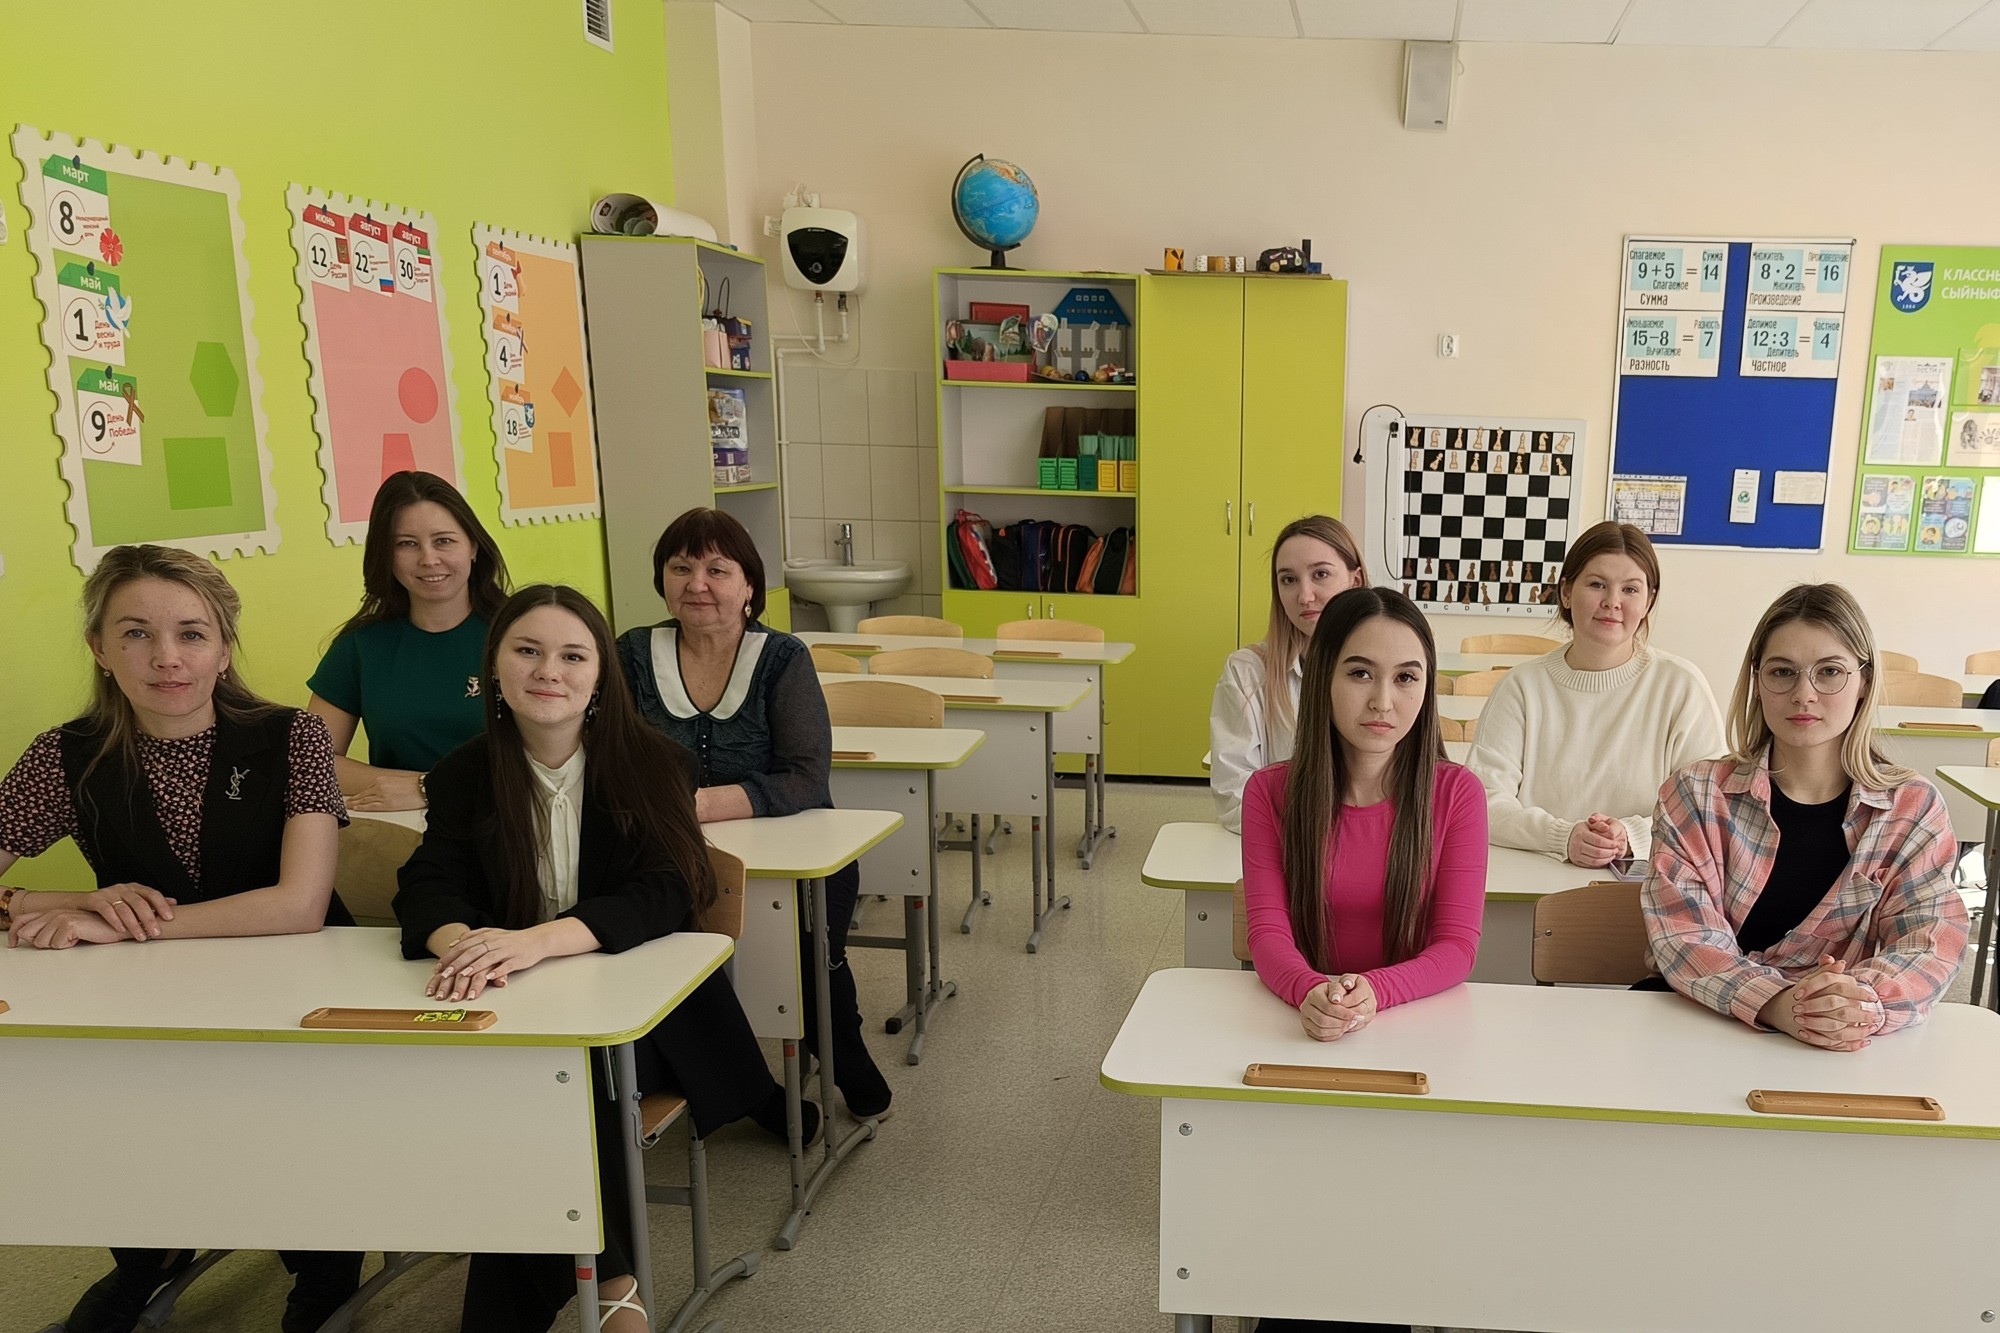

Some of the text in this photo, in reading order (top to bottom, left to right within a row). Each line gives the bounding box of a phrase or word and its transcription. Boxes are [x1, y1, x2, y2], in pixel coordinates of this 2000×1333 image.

[62, 165, 90, 184] март
[60, 200, 74, 235] 8
[315, 212, 336, 228] июнь
[360, 220, 382, 236] август
[402, 230, 422, 246] август
[312, 245, 328, 268] 12
[354, 252, 370, 274] 22
[1630, 250, 1666, 260] Слагаемое
[1702, 251, 1723, 262] Сумма
[400, 259, 414, 280] 30
[1638, 262, 1648, 279] 9
[1664, 262, 1675, 279] 5
[1704, 264, 1719, 280] 14
[1760, 263, 1771, 280] 8
[1784, 264, 1796, 280] 2
[1823, 264, 1840, 281] 16
[80, 276, 102, 291] май
[494, 272, 502, 296] 1
[1652, 280, 1688, 290] Слагаемое
[1640, 293, 1668, 306] Сумма
[1748, 292, 1802, 306] Произведение
[74, 308, 88, 342] 1
[1747, 318, 1777, 329] Делимое
[1813, 320, 1840, 331] Частное
[1704, 331, 1714, 347] 7
[1752, 330, 1769, 346] 12
[1780, 331, 1789, 347] 3
[1820, 332, 1830, 348] 4
[500, 345, 508, 368] 4
[1766, 347, 1799, 358] Делитель
[1630, 358, 1670, 371] Разность
[1752, 360, 1787, 372] Частное
[98, 379, 120, 392] май
[92, 410, 106, 442] 9
[108, 426, 136, 438] Победы
[506, 419, 518, 436] 18
